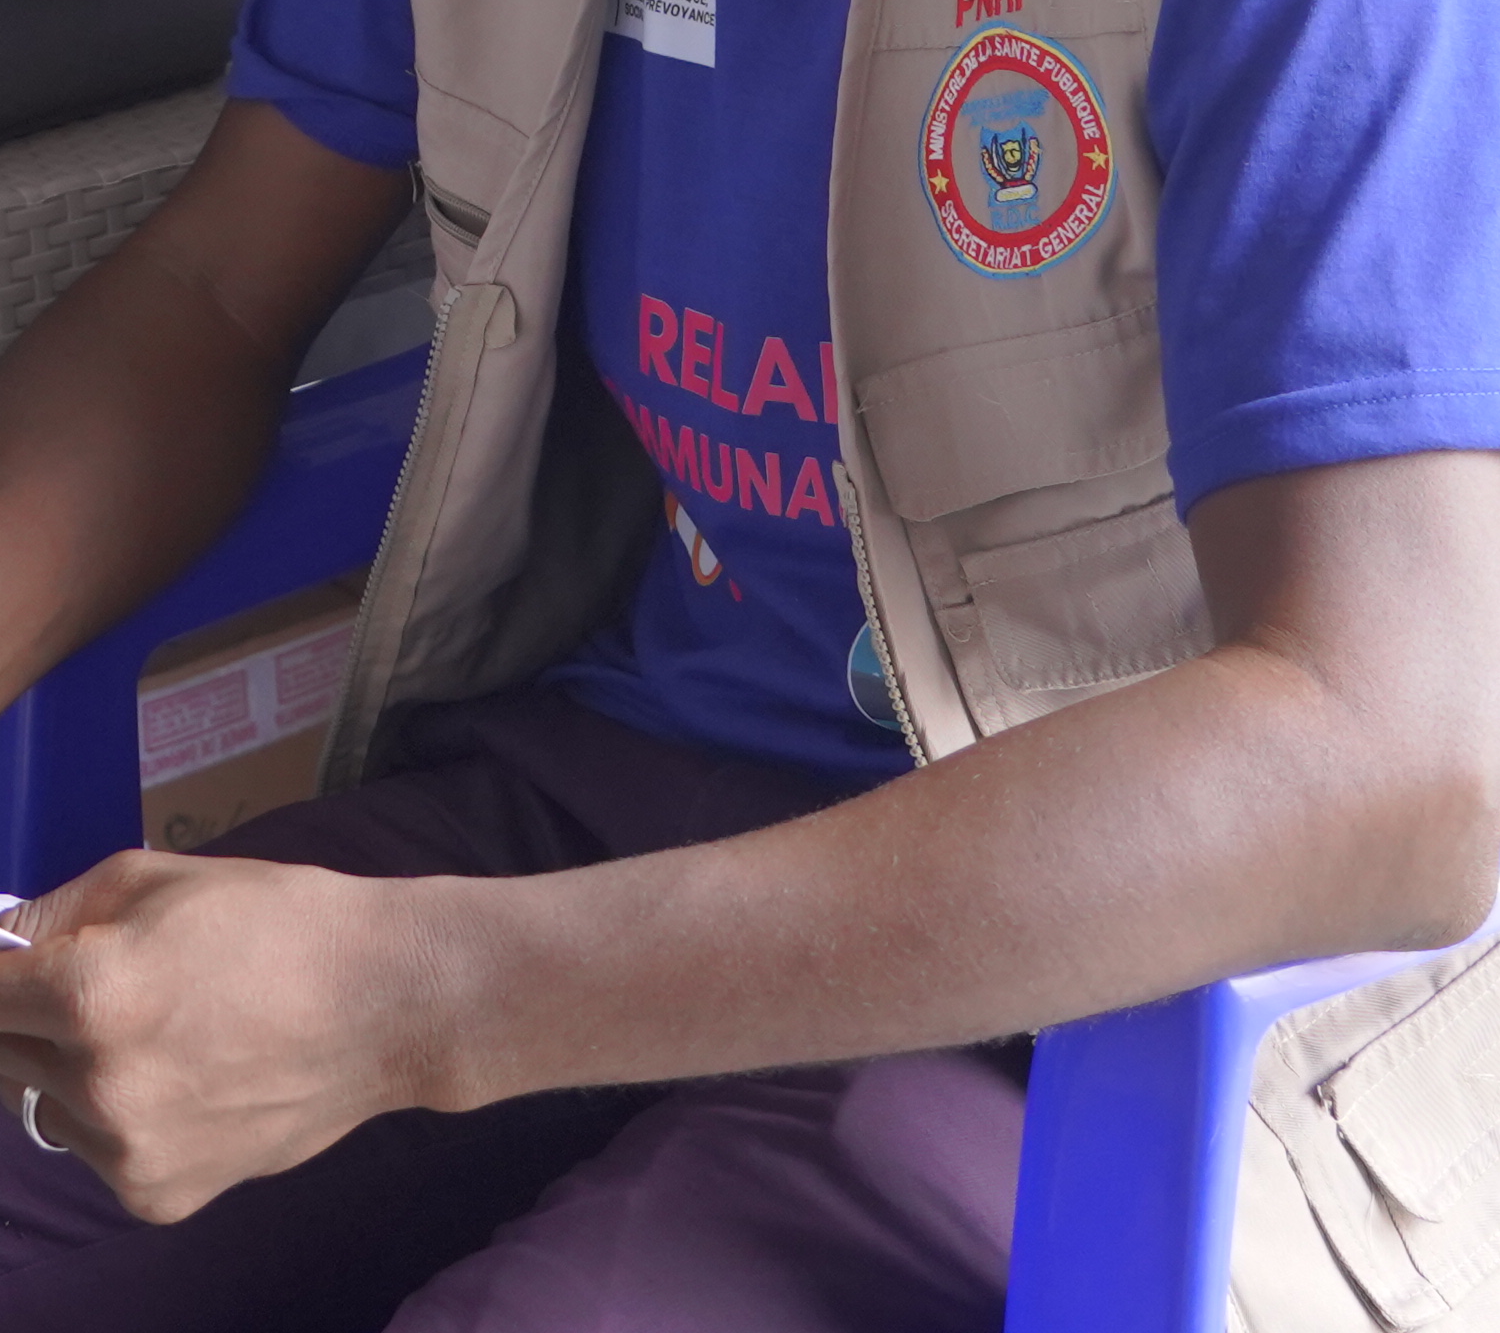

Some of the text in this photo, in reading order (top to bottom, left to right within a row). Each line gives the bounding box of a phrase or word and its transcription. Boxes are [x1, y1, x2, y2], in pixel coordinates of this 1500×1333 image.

[928, 67, 967, 161] MINISTERE
[961, 50, 980, 76] DE
[978, 38, 994, 63] LA
[994, 35, 1041, 68] SANTE
